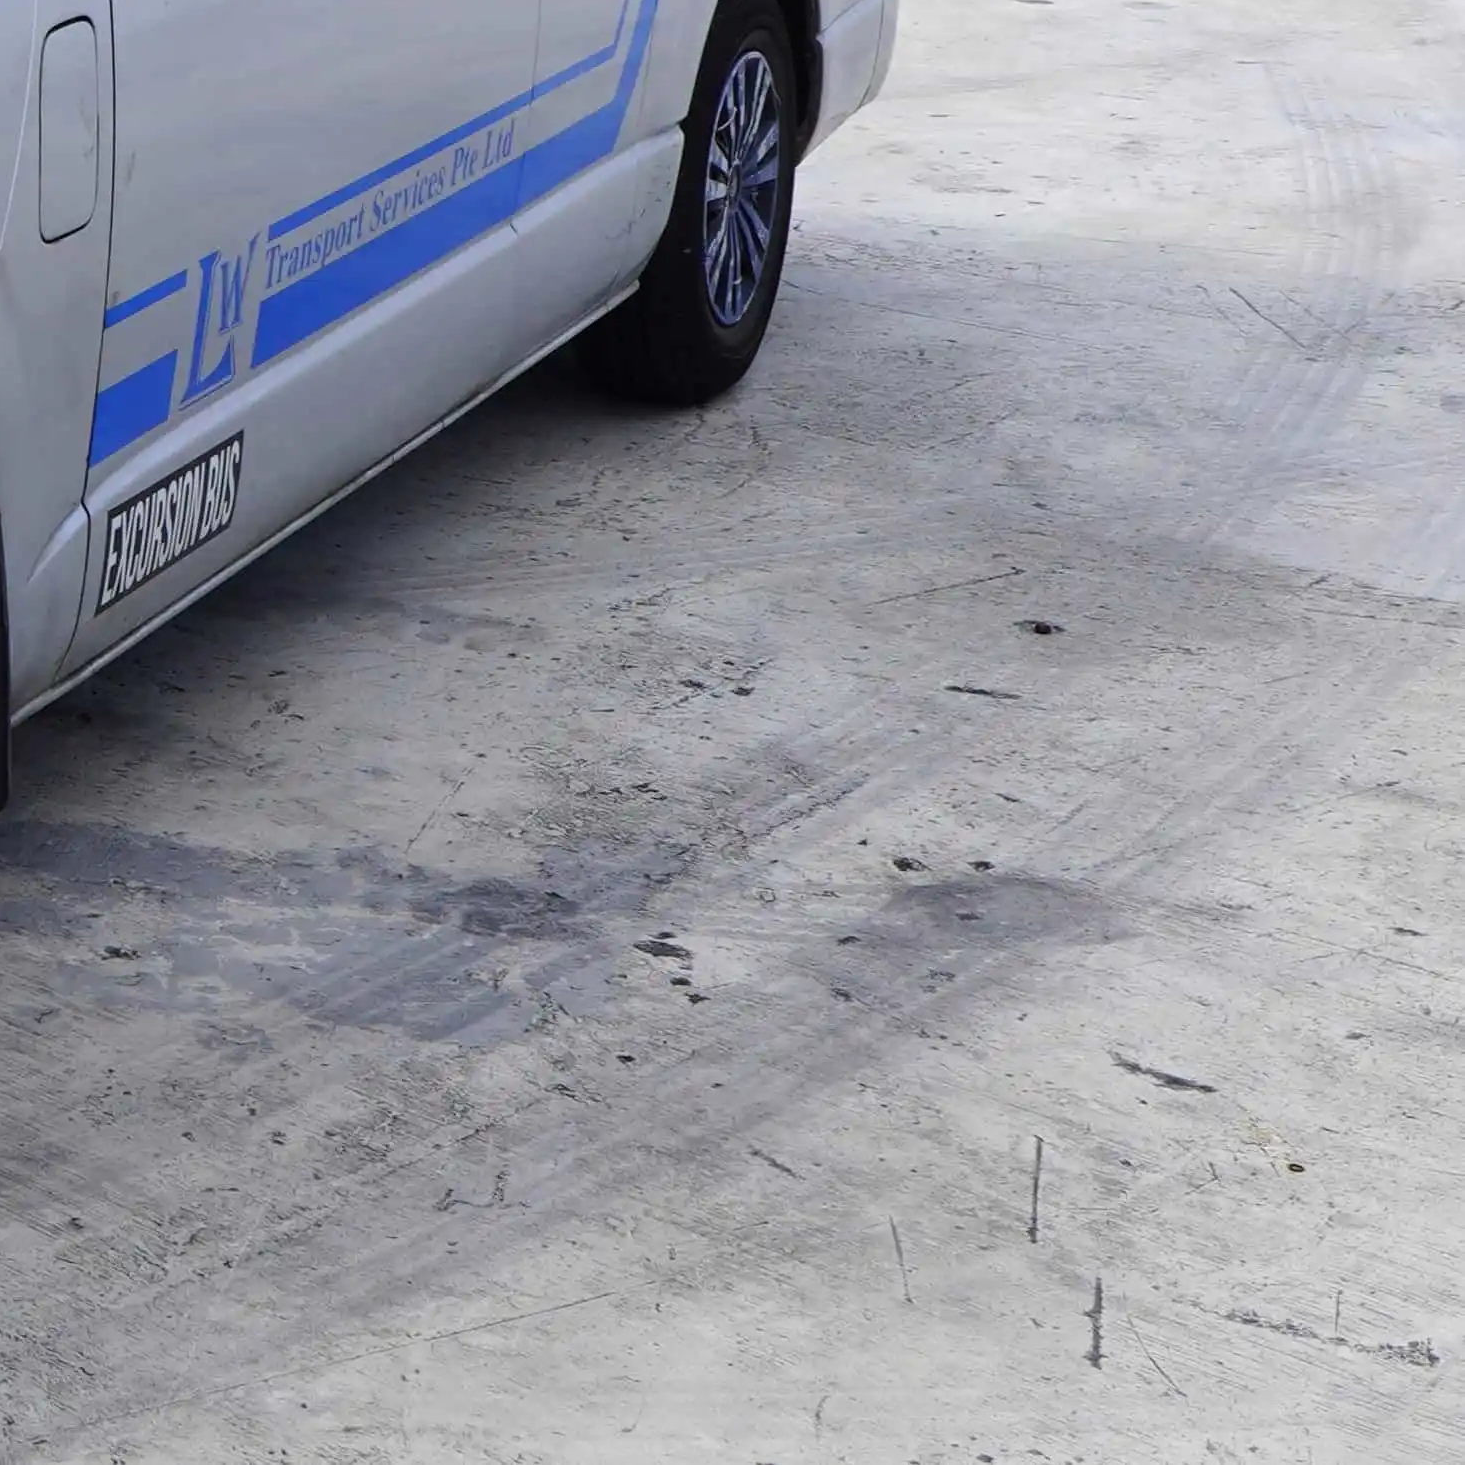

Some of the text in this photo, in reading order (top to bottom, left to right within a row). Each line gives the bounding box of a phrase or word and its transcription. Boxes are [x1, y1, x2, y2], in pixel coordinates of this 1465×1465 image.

[266, 118, 517, 290] Transport Services Pte Ltd
[178, 231, 261, 412] LW
[101, 440, 241, 606] EXCURSION BUS
